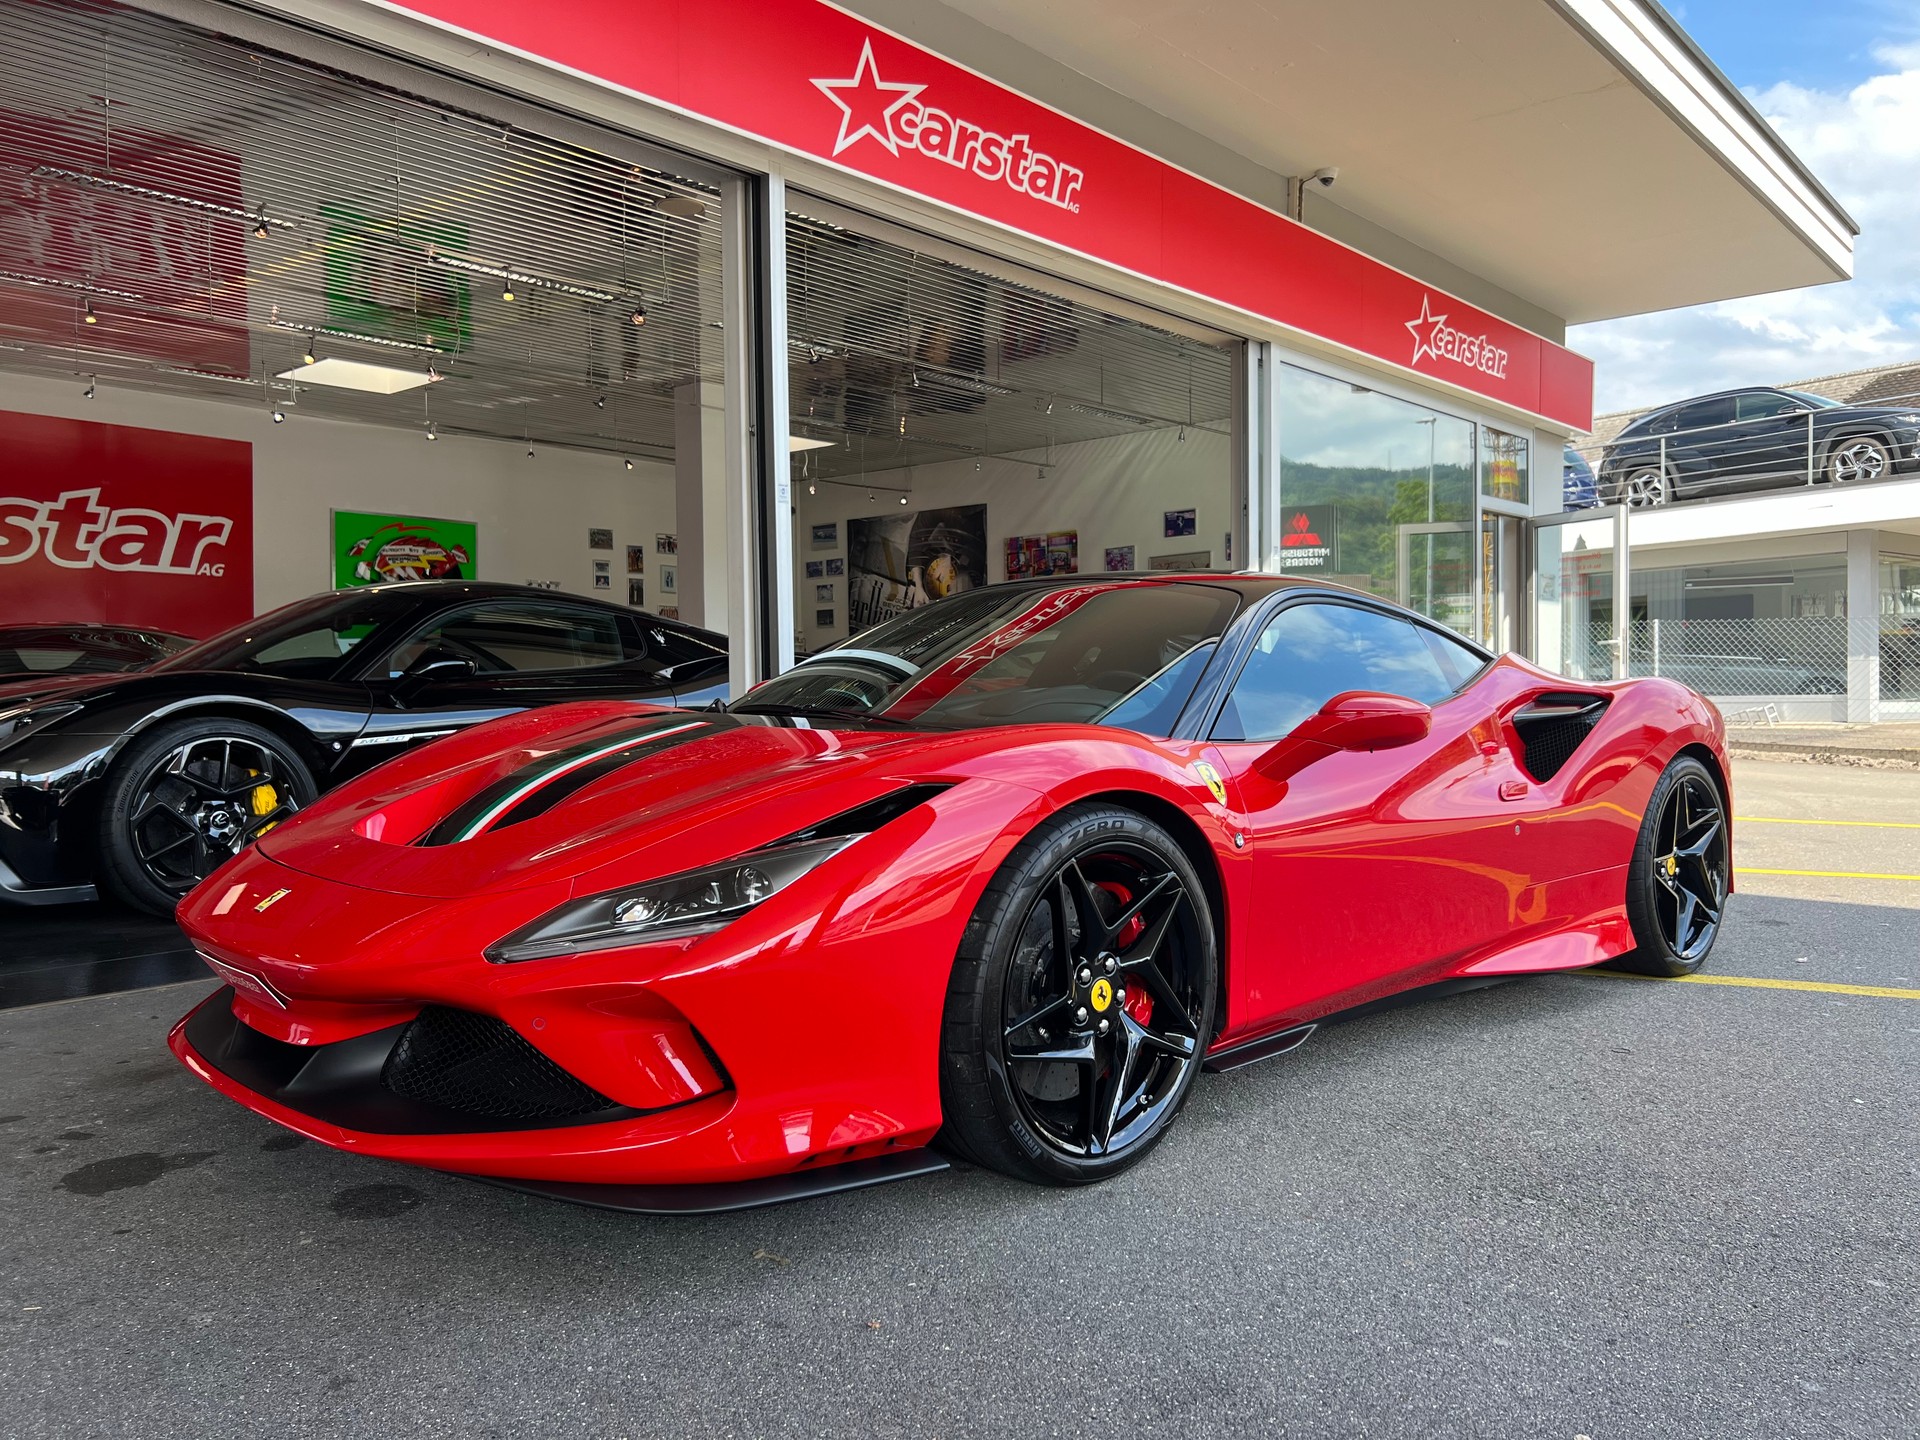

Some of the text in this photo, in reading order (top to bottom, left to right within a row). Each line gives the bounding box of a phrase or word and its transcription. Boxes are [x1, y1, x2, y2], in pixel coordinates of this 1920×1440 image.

[891, 98, 1084, 214] carstar AG
[1433, 324, 1507, 378] carstar
[197, 563, 225, 577] AG
[1068, 820, 1125, 843] ZERO
[1009, 1119, 1042, 1159] PIRELLI
